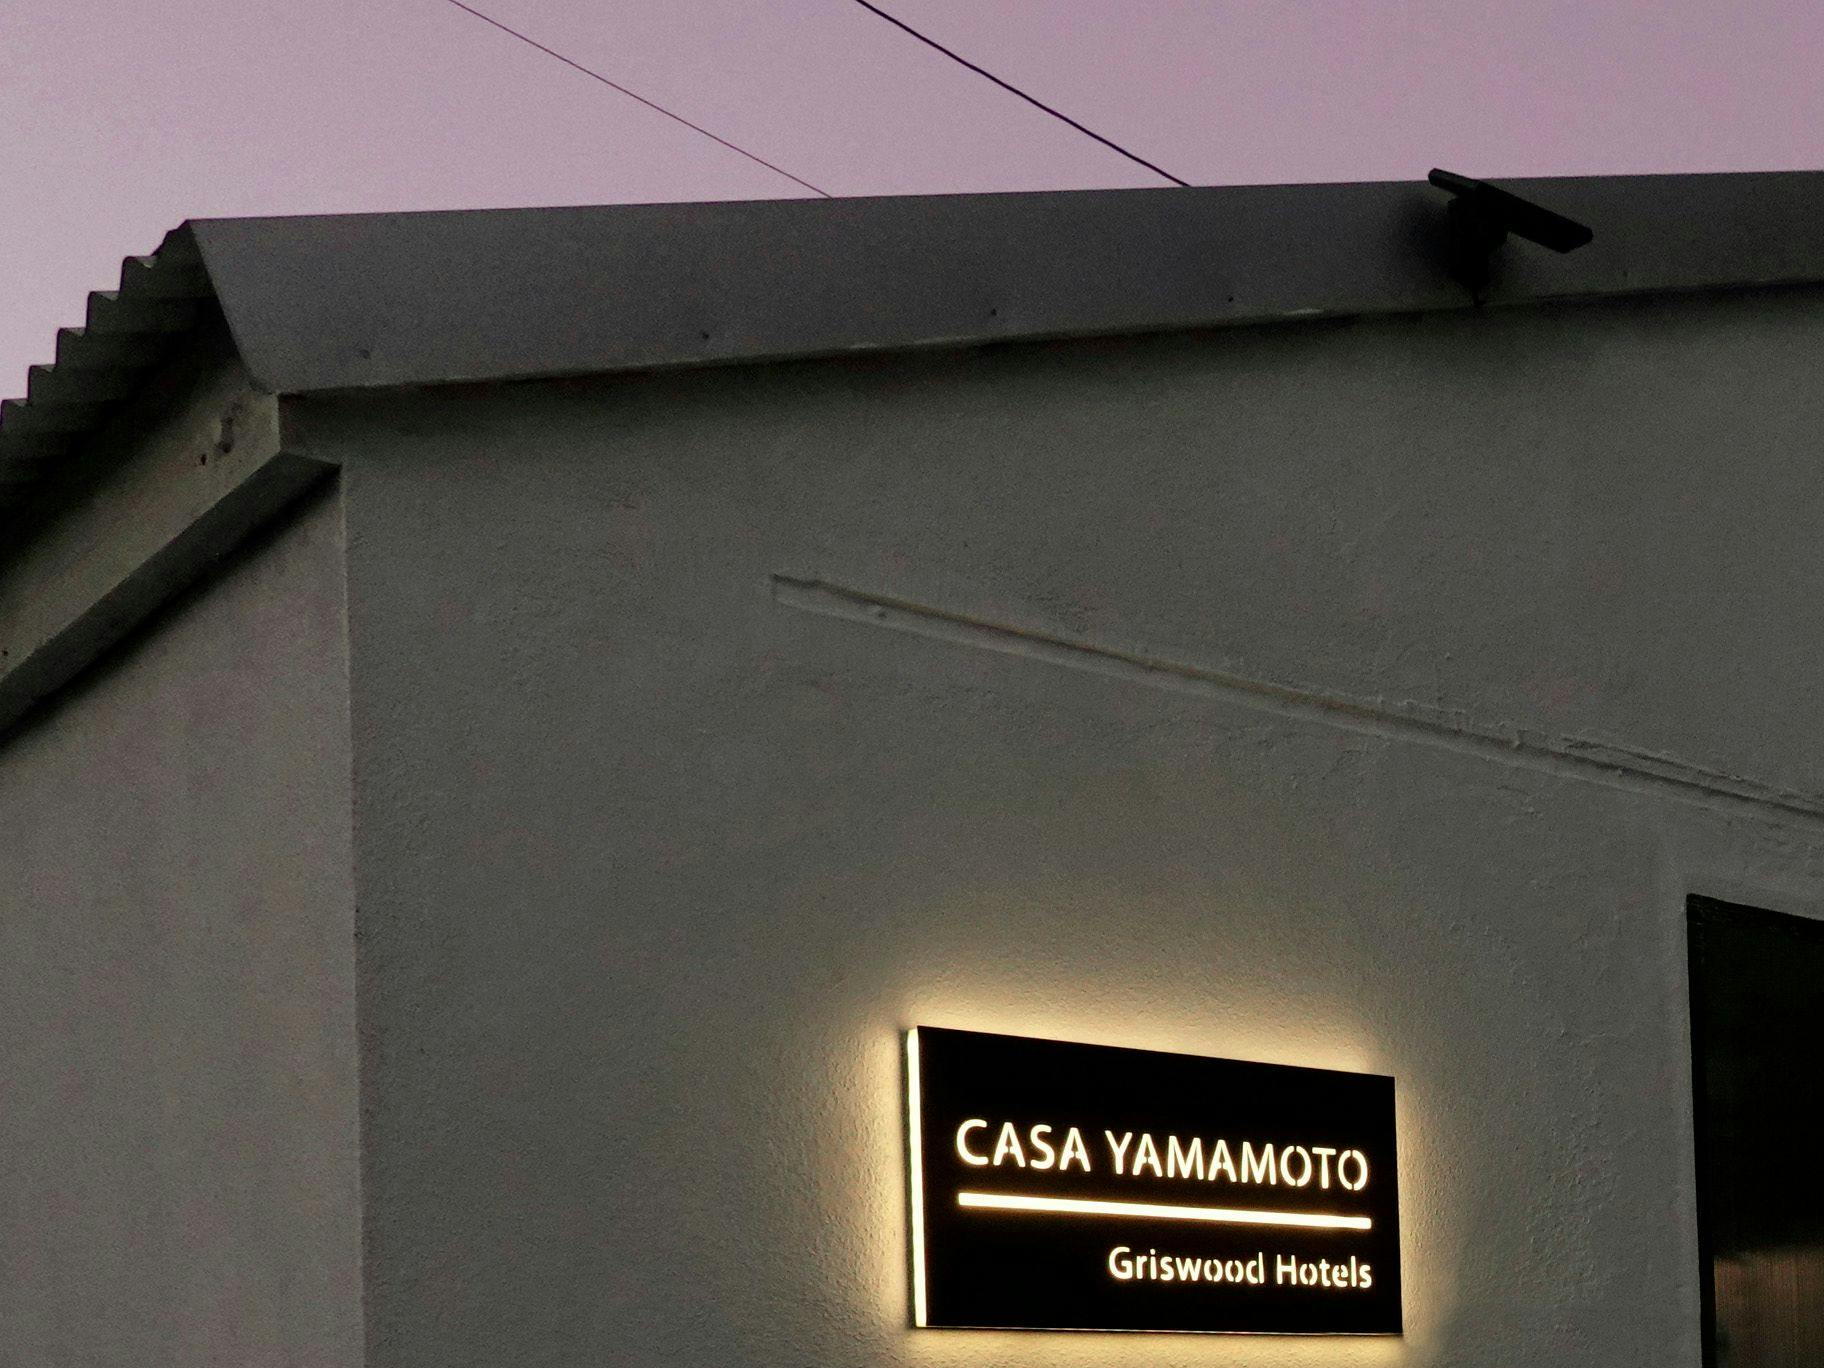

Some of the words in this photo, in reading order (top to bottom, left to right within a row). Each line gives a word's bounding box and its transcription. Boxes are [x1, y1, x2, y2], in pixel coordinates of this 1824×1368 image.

[955, 1118, 1092, 1173] CASA
[1104, 1129, 1369, 1192] YAMAMOTO
[1108, 1246, 1265, 1284] Griswood
[1276, 1252, 1373, 1289] Hotels
